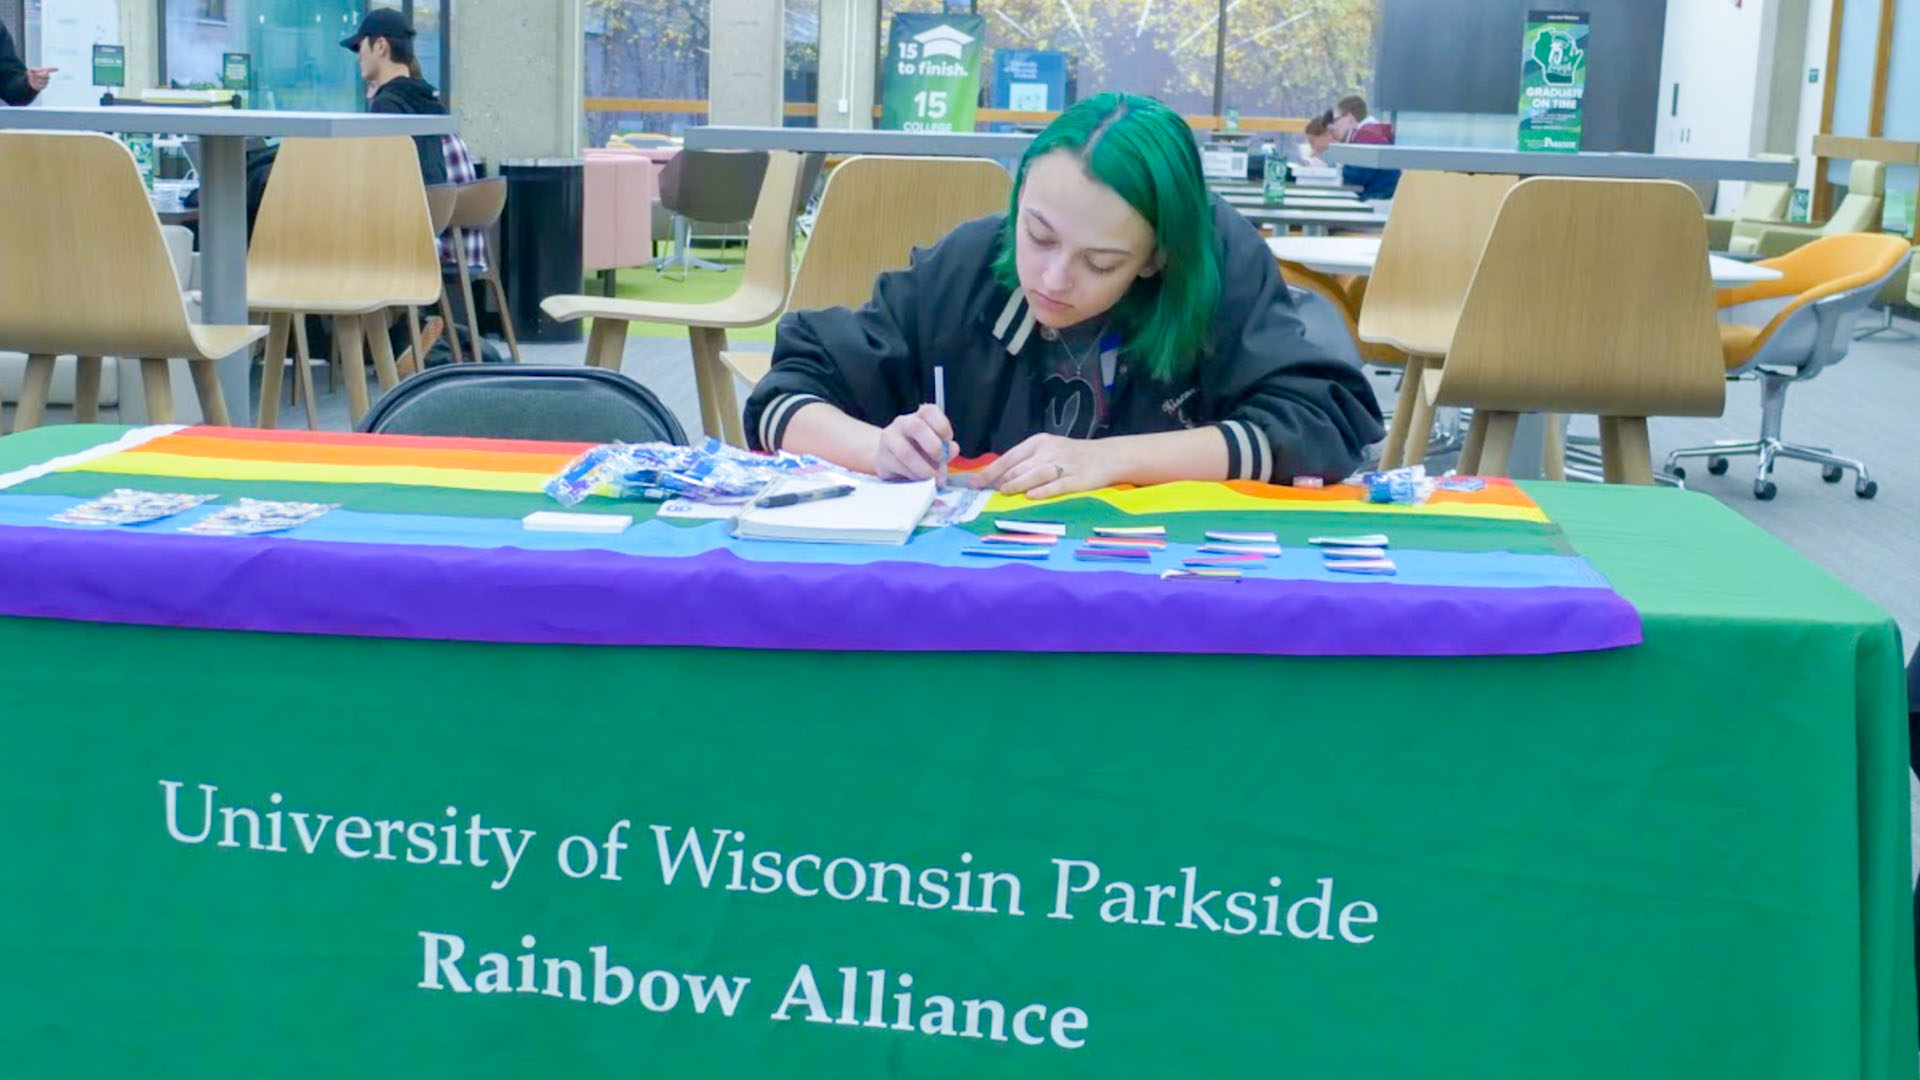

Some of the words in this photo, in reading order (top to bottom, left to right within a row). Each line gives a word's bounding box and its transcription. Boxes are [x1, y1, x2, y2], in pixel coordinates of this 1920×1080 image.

[898, 42, 919, 59] 15
[898, 61, 916, 75] to
[919, 61, 969, 77] finish.
[1525, 87, 1585, 98] GRADUATE
[914, 91, 948, 118] 15
[1532, 98, 1551, 108] ON
[1553, 98, 1577, 110] TIME
[160, 780, 537, 890] University
[557, 819, 631, 881] of
[650, 825, 1025, 916] Wisconsin
[1047, 858, 1378, 944] Parkside
[418, 931, 751, 1017] Rainbow
[770, 964, 1089, 1049] Alliance
